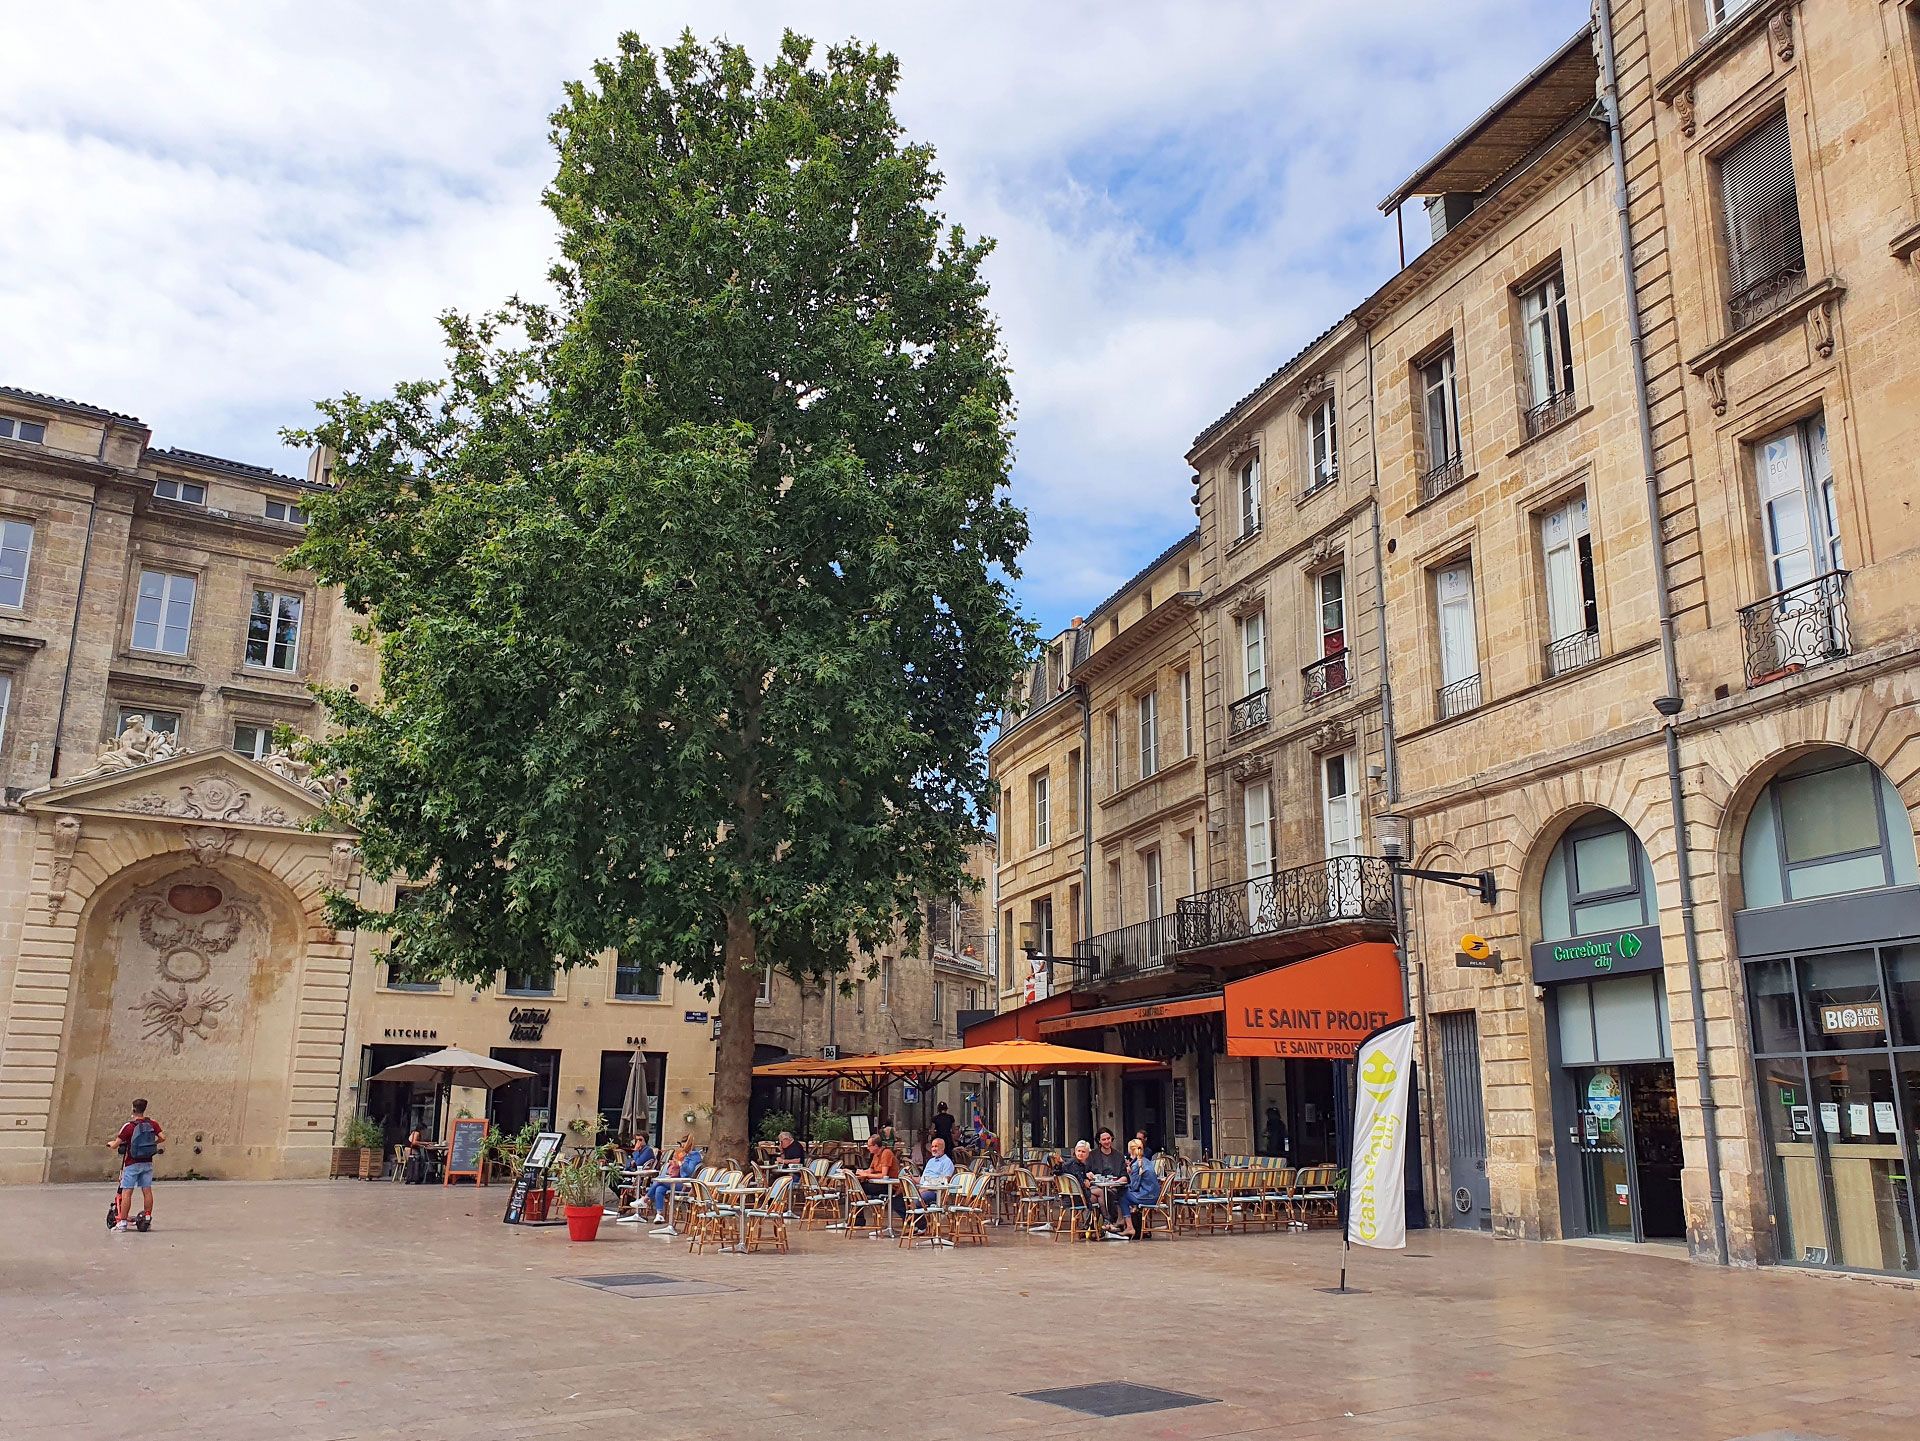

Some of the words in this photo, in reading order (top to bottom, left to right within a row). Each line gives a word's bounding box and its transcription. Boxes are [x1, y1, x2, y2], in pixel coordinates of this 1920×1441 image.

[1770, 458, 1788, 475] BCV
[1553, 940, 1612, 962] Carrefour
[1594, 956, 1613, 971] city
[509, 1006, 551, 1024] Central
[1245, 1008, 1264, 1028] LE
[1269, 1008, 1321, 1030] SAINT
[1327, 1010, 1389, 1031] PROJET
[1825, 1008, 1857, 1030] BIO
[1858, 1015, 1880, 1027] PLUS
[384, 1028, 437, 1039] KITCHEN
[509, 1024, 543, 1041] Hostel
[626, 1036, 647, 1045] BAR
[1274, 1041, 1287, 1054] LE
[1290, 1041, 1323, 1055] SAINT
[1327, 1042, 1359, 1055] PROJ
[1360, 1112, 1387, 1240] Carrefour
